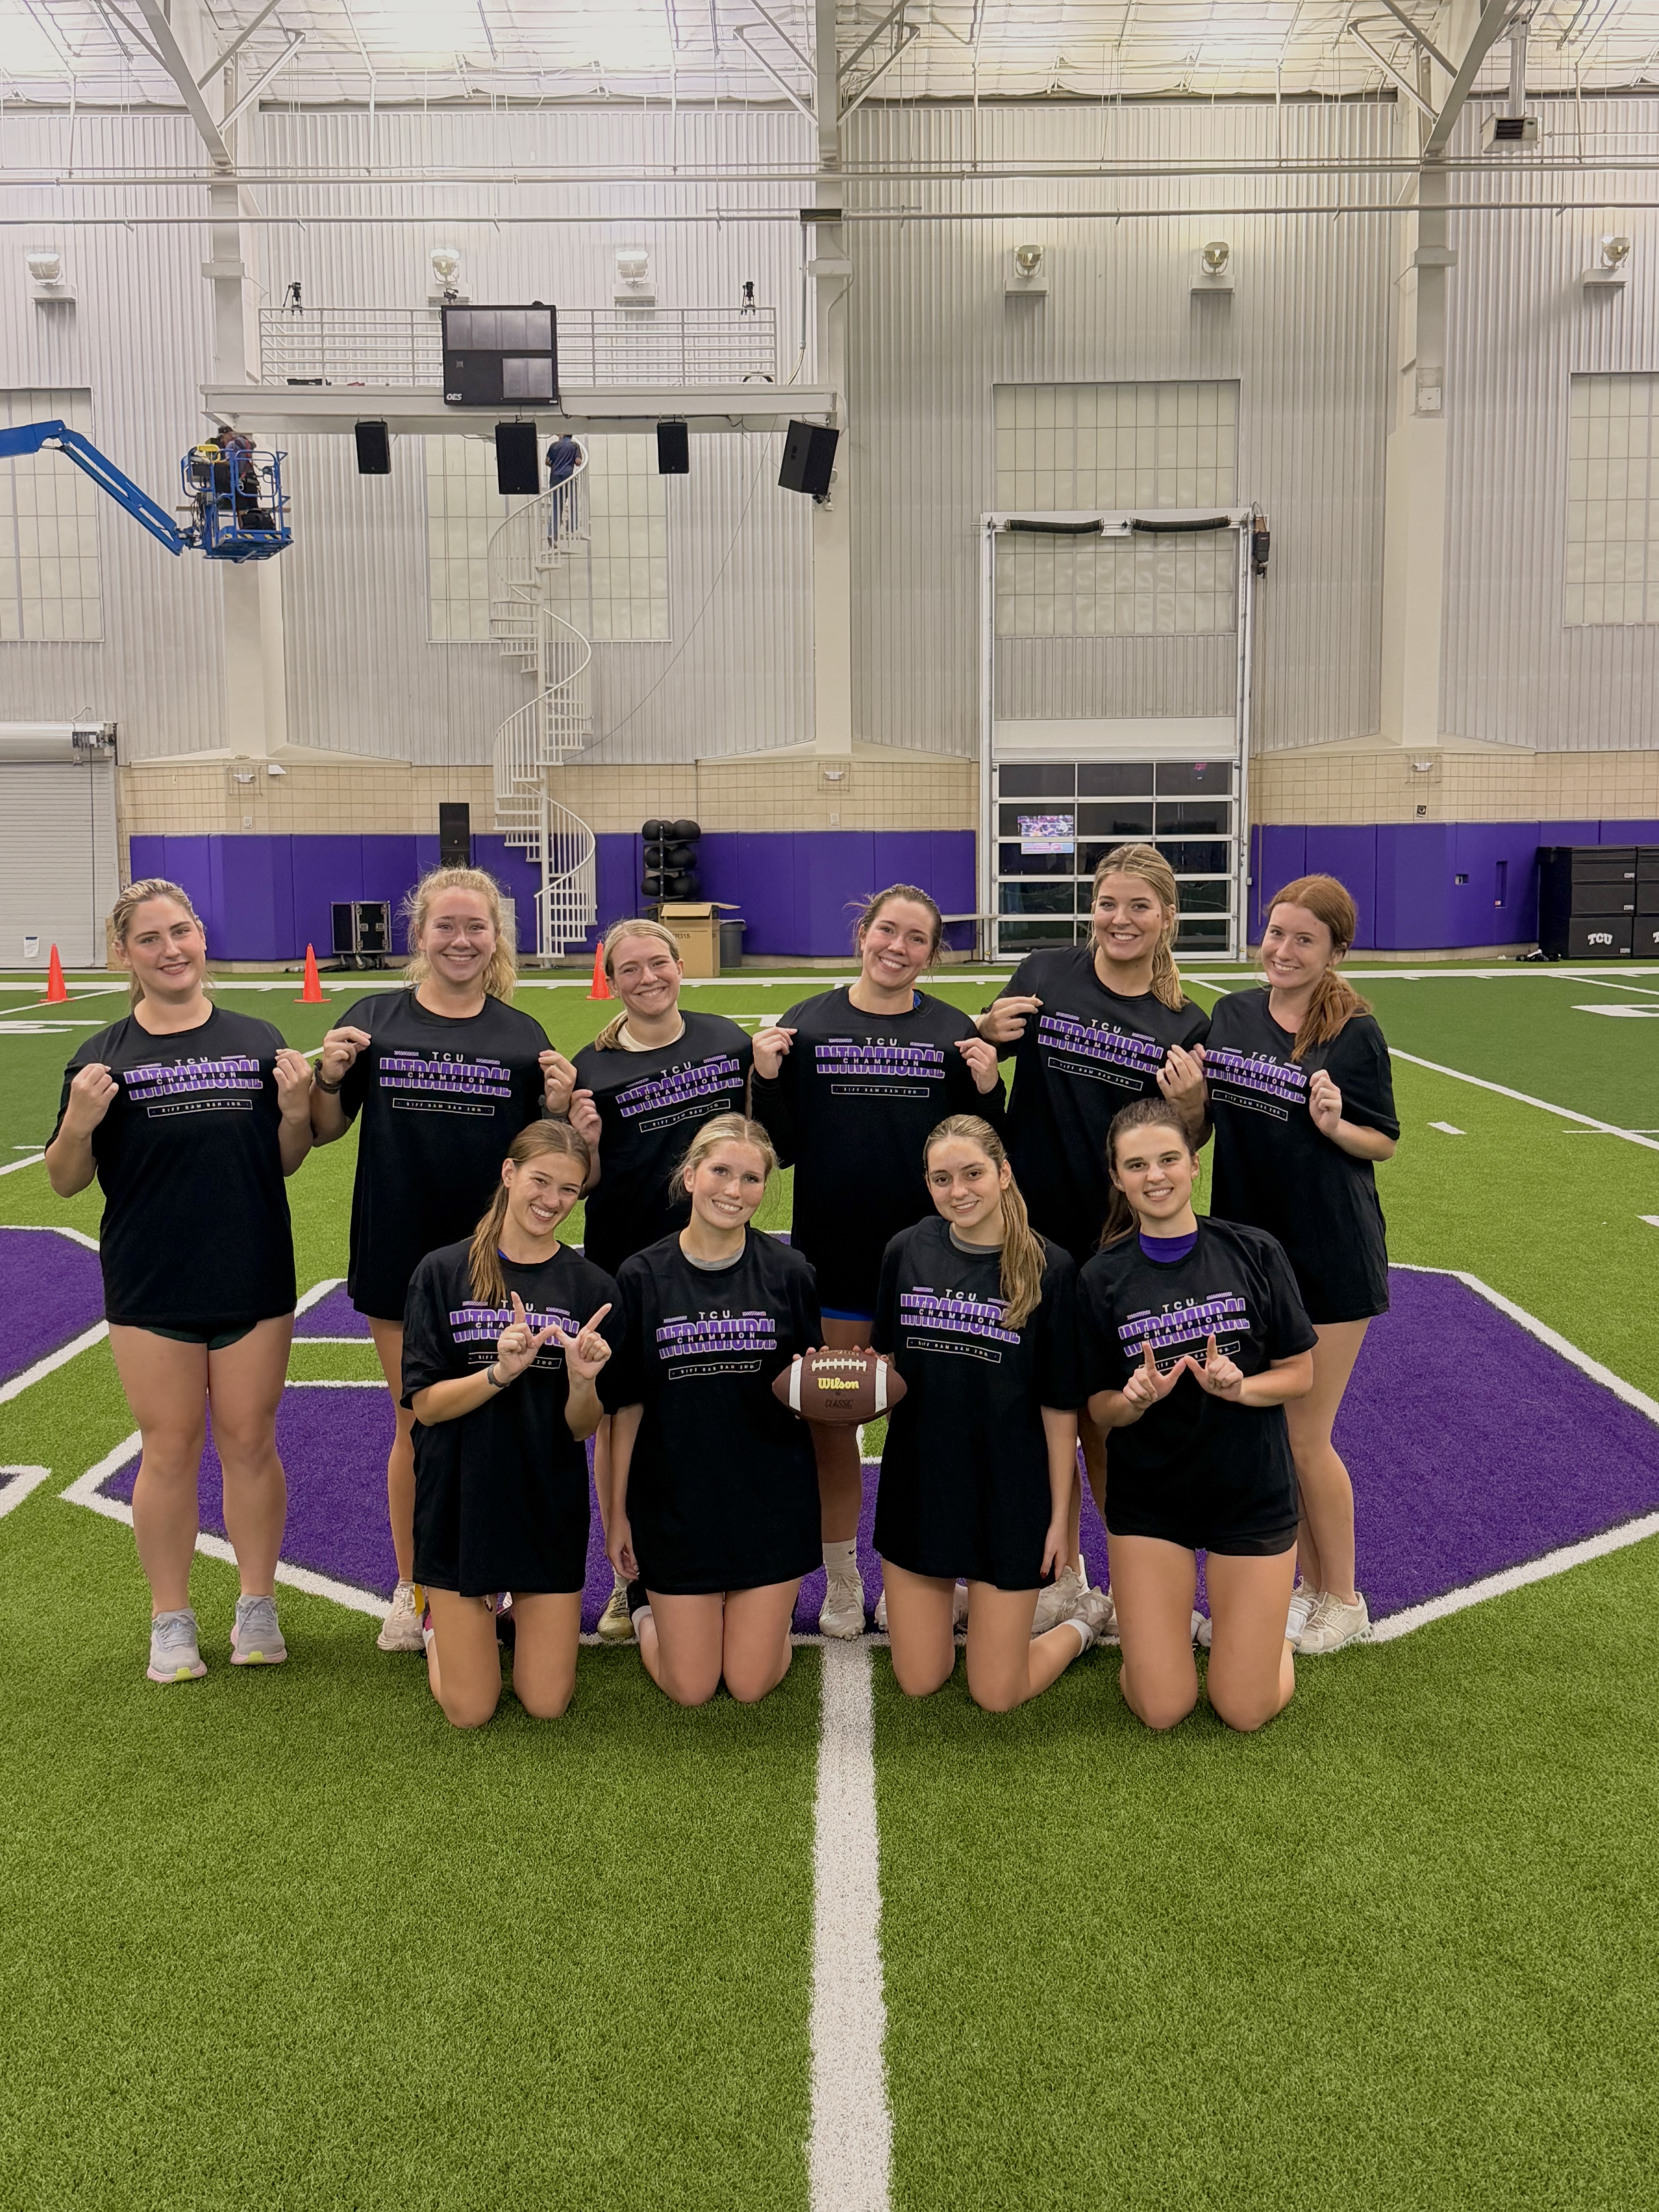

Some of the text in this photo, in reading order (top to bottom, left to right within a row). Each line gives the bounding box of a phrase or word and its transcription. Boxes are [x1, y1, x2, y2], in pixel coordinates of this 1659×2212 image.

[1588, 933, 1613, 945] TCU
[1091, 1019, 1121, 1034] TCU
[866, 1037, 897, 1046] TCU
[1065, 1035, 1137, 1059] CHAMPION
[175, 1057, 208, 1065] TCU
[432, 1052, 464, 1062] TCU
[843, 1058, 919, 1066] CHAMPION
[1250, 1052, 1276, 1063] TCU
[661, 1061, 691, 1077] TCU
[156, 1072, 237, 1085] CHAMPION
[408, 1072, 485, 1084] CHAMPION
[1225, 1066, 1285, 1087] CHAMPION
[645, 1075, 718, 1100] CHAMPION
[945, 1289, 976, 1302] TCU
[501, 1300, 534, 1311] TU
[1162, 1298, 1195, 1313] TCU
[699, 1310, 730, 1320] TCU
[919, 1308, 995, 1326] CHAMPION
[1144, 1314, 1223, 1339] CHAMPION
[677, 1332, 755, 1344] CHAMPION
[817, 1377, 859, 1389] Wilson
